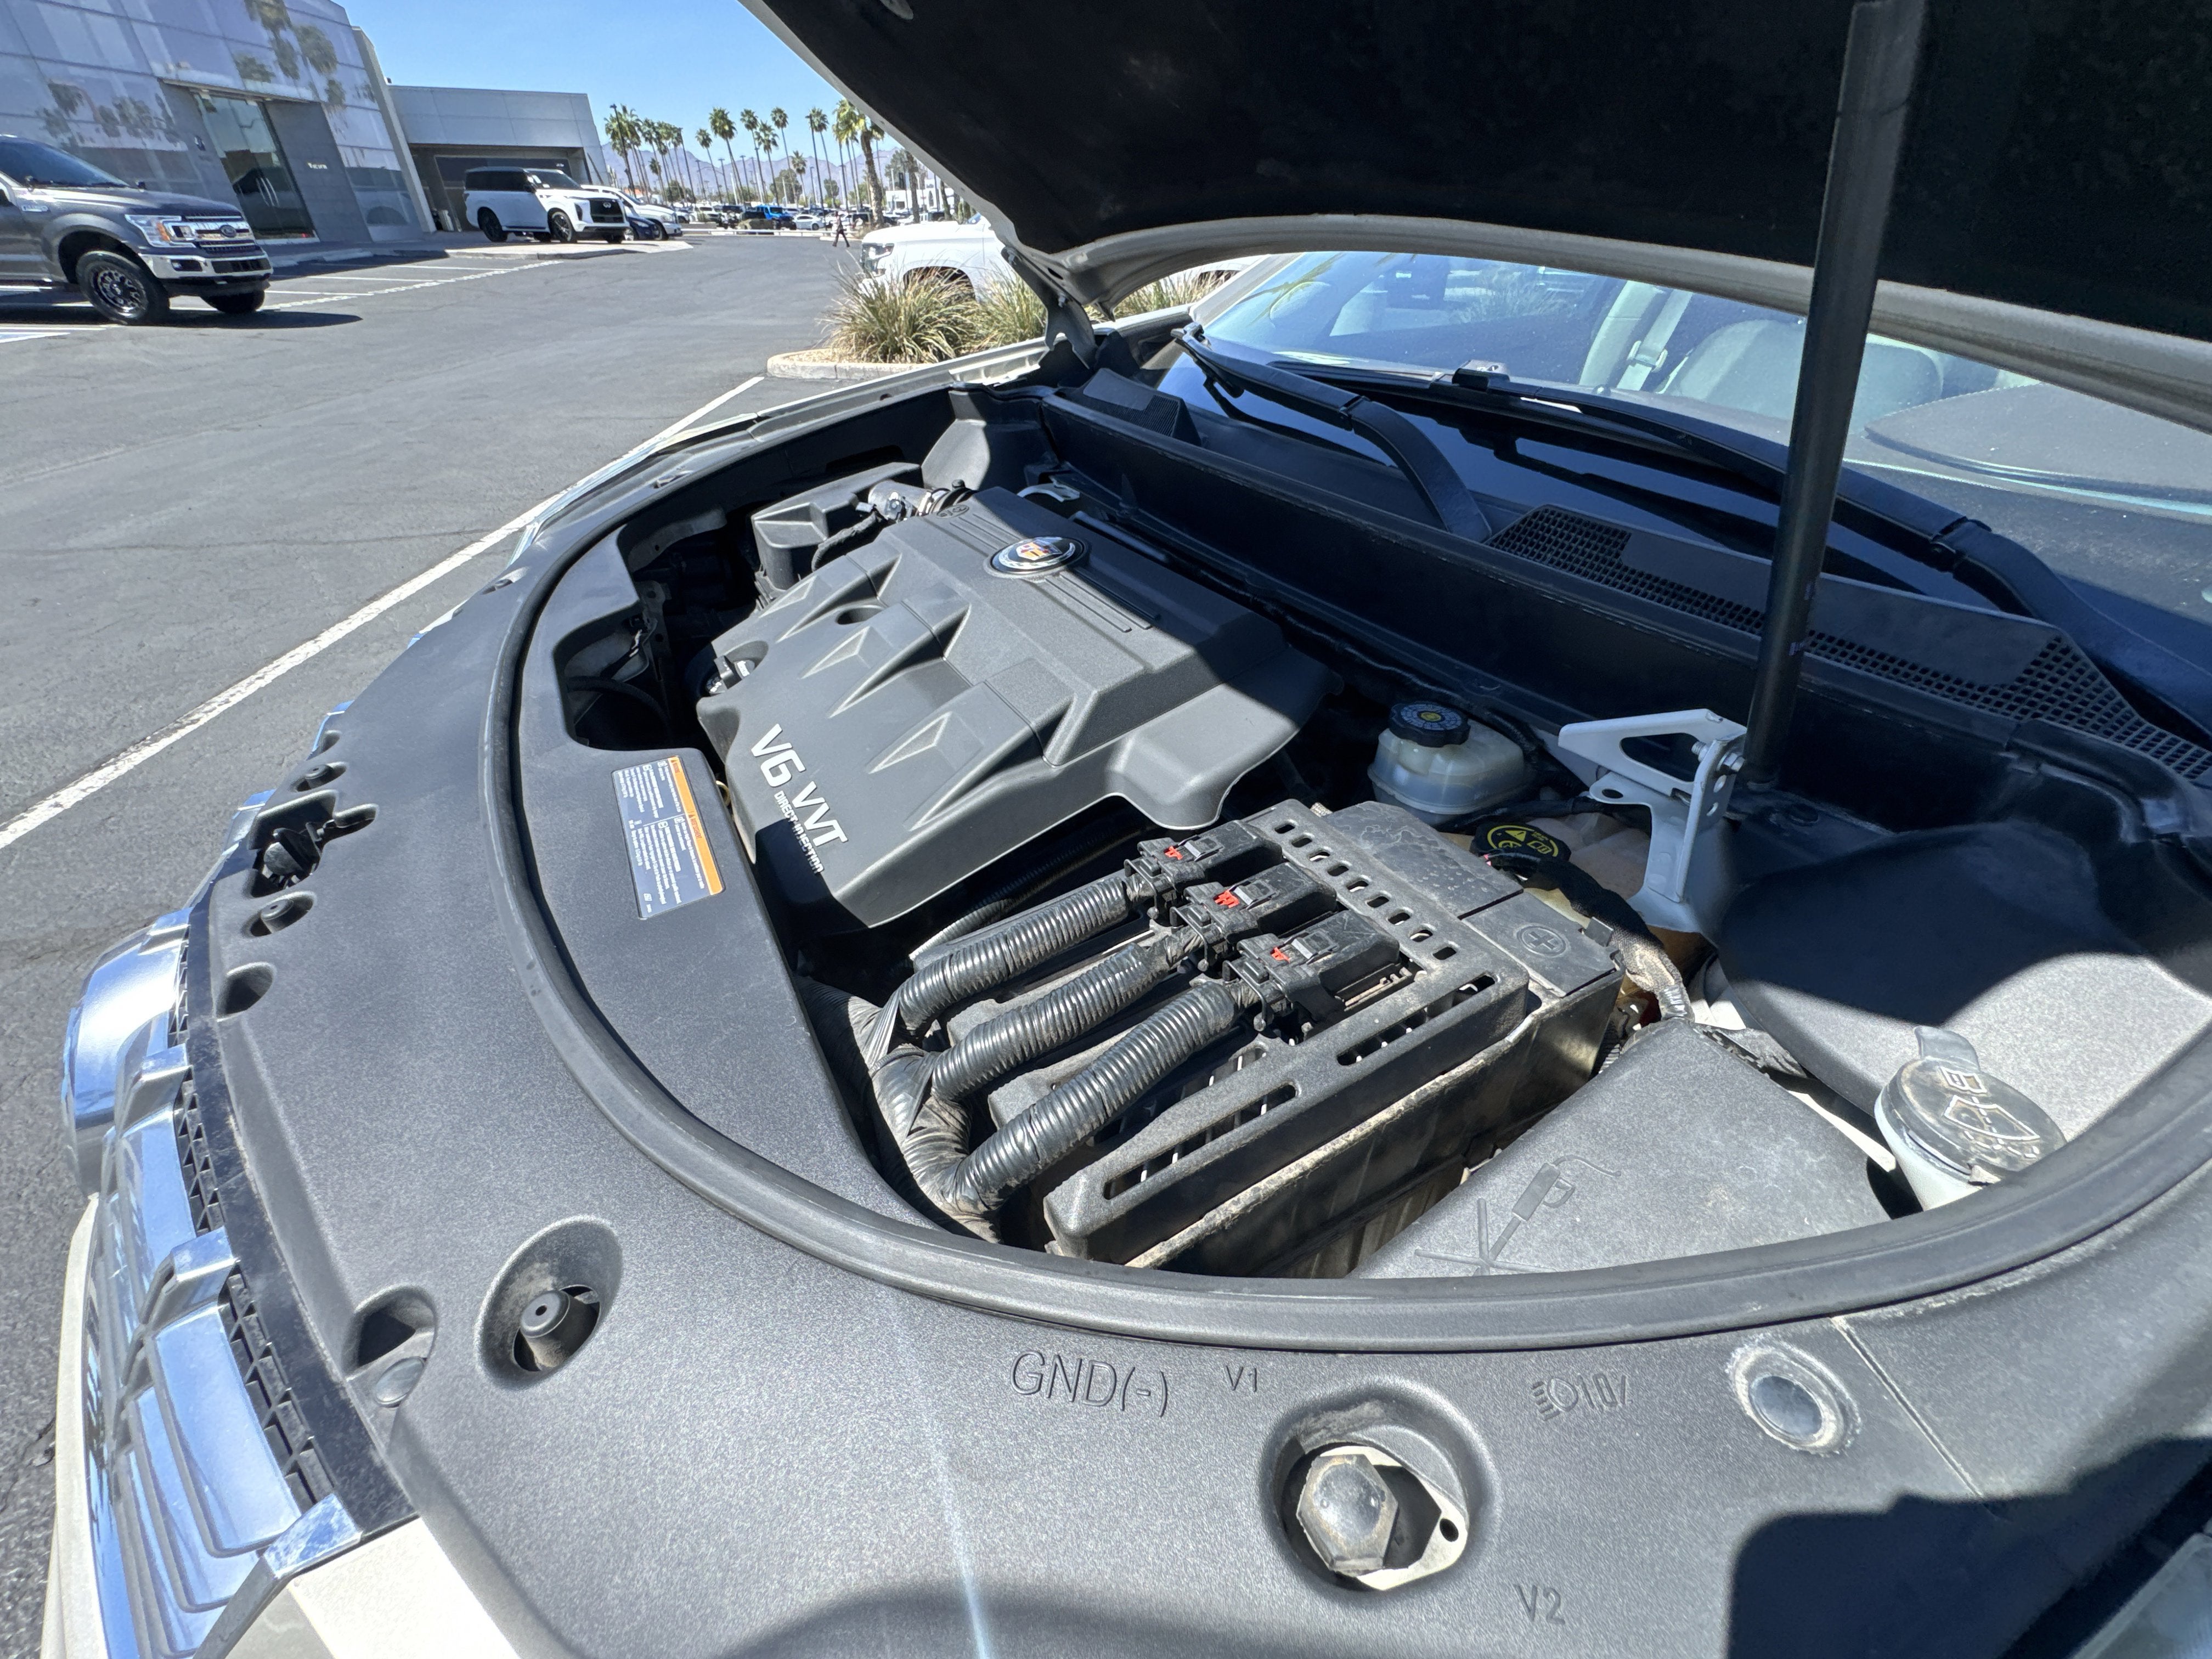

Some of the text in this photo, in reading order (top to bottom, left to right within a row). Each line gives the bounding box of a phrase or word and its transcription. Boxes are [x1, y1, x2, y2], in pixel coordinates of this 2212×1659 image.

[751, 724, 849, 847] V6 VVT
[774, 791, 825, 874] DIRECT INJECTION
[1010, 1350, 1168, 1418] GND(-)
[1224, 1365, 1257, 1393] V1
[1513, 1584, 1566, 1625] V2
